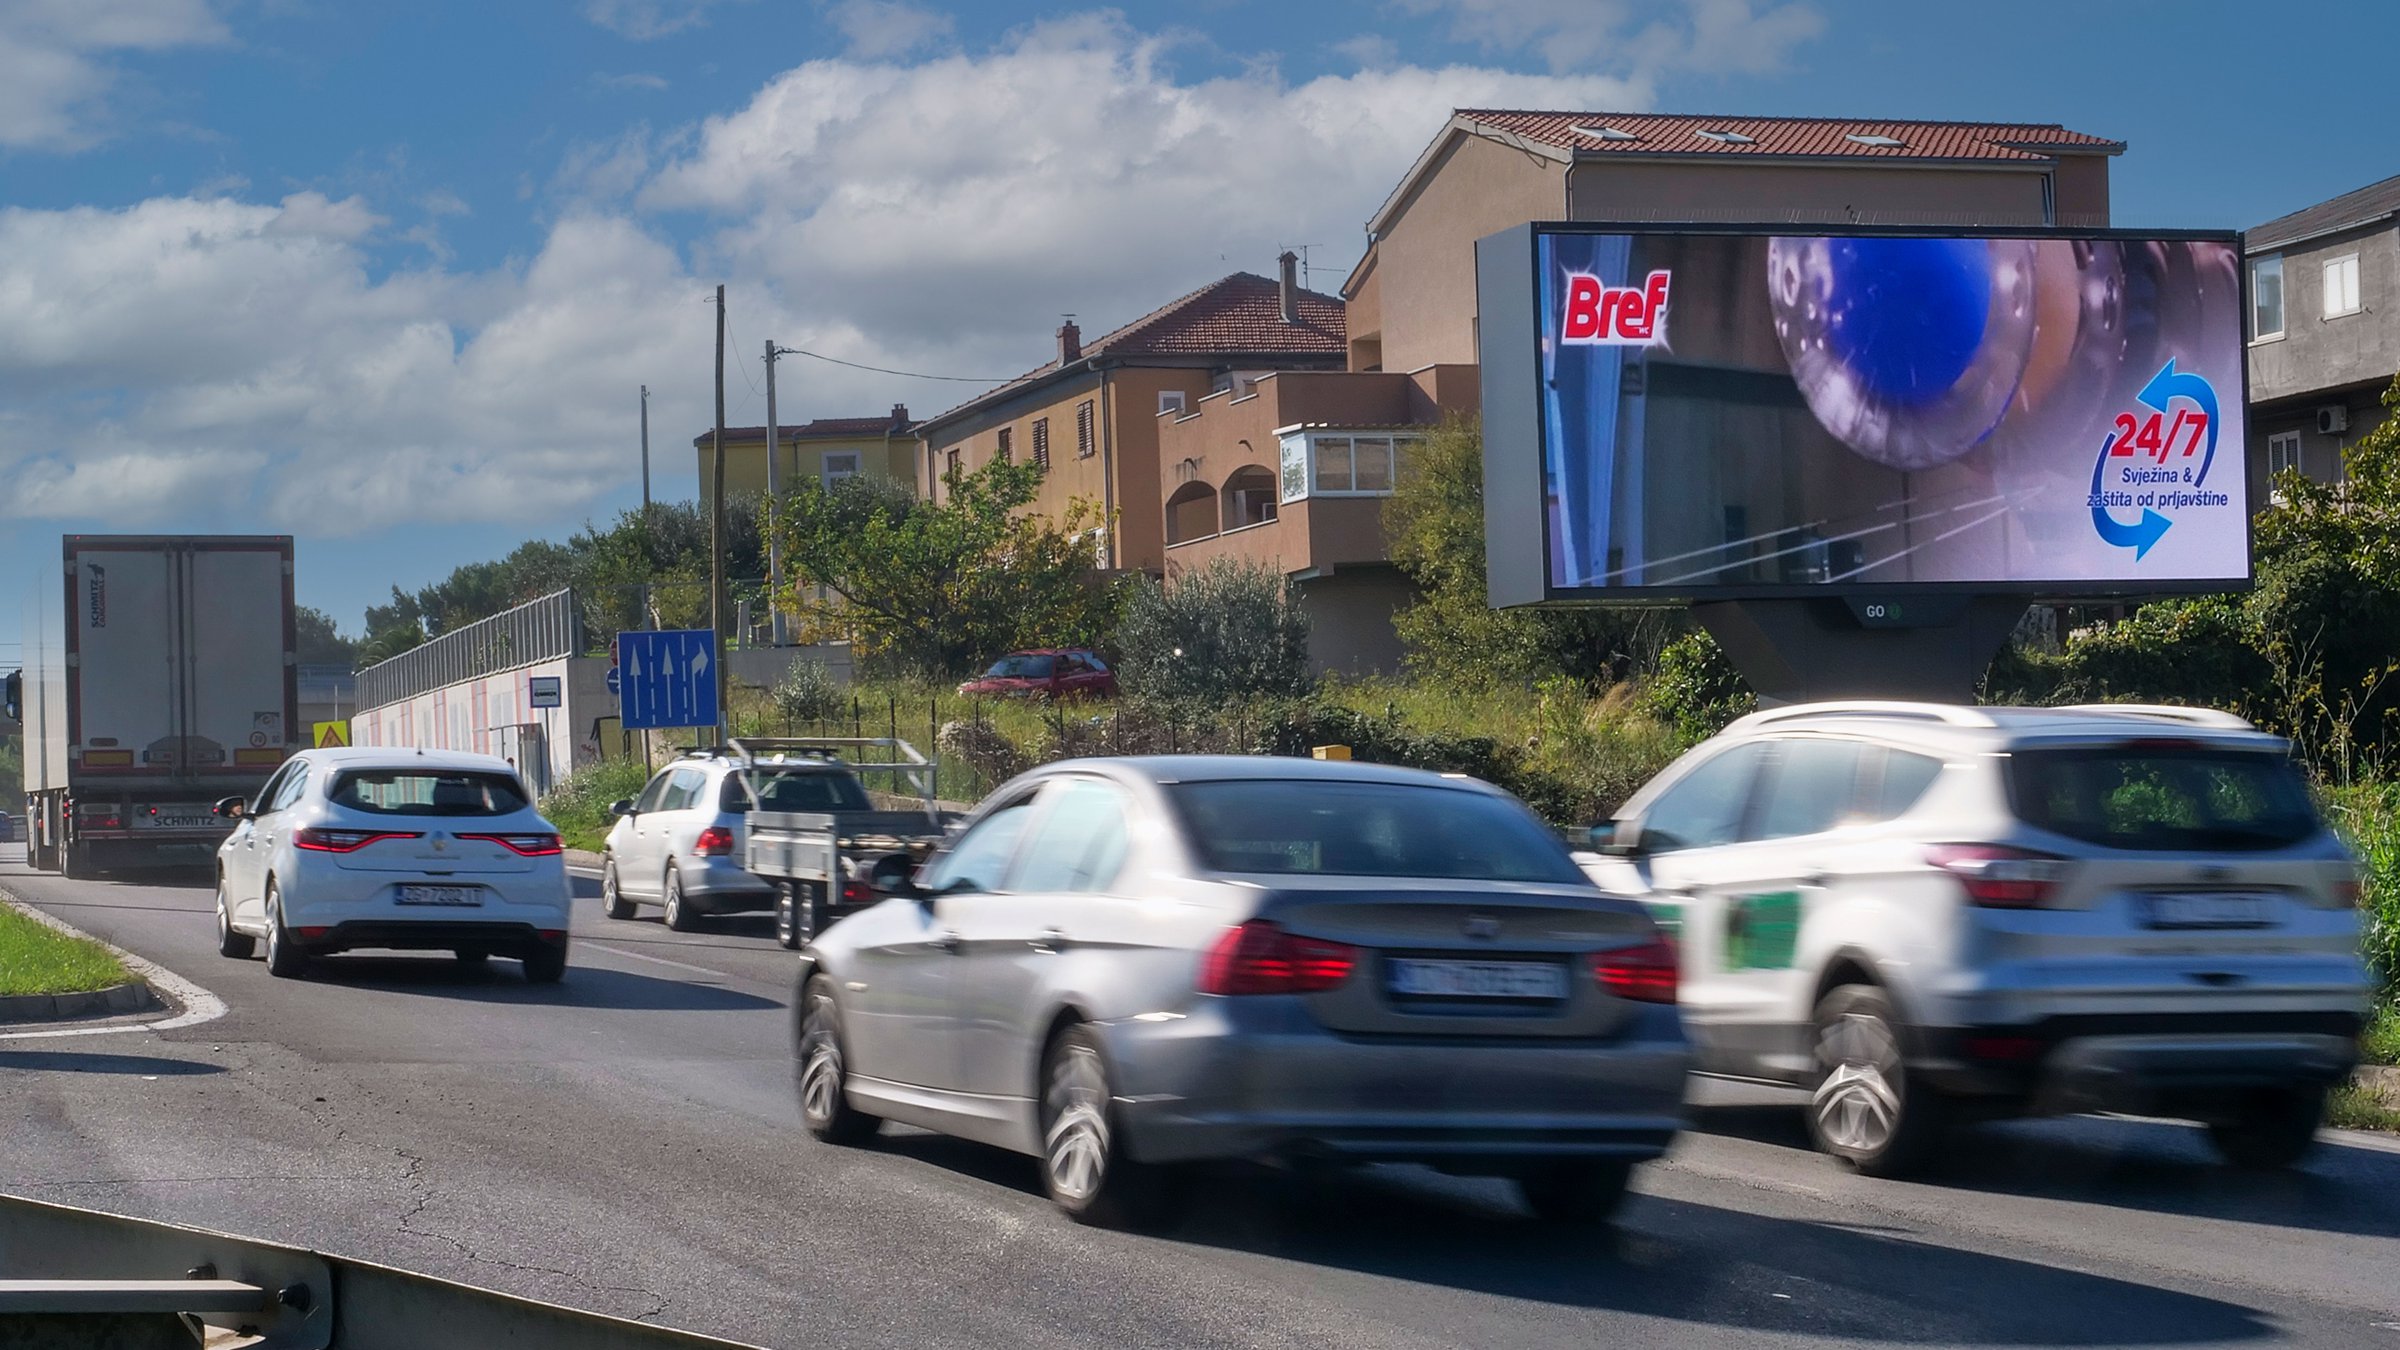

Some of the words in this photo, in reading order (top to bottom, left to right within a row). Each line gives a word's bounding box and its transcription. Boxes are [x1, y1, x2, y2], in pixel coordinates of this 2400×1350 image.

[1565, 273, 1668, 338] Bref
[2110, 409, 2209, 464] 24/7
[2122, 467, 2178, 486] Svježina
[2183, 467, 2193, 483] &
[2087, 491, 2132, 507] zaštita
[2137, 491, 2155, 507] od
[2158, 490, 2228, 510] prljavštine
[91, 579, 99, 628] SCHMITZ
[1866, 604, 1885, 618] GO
[154, 816, 215, 826] SCHMITZ
